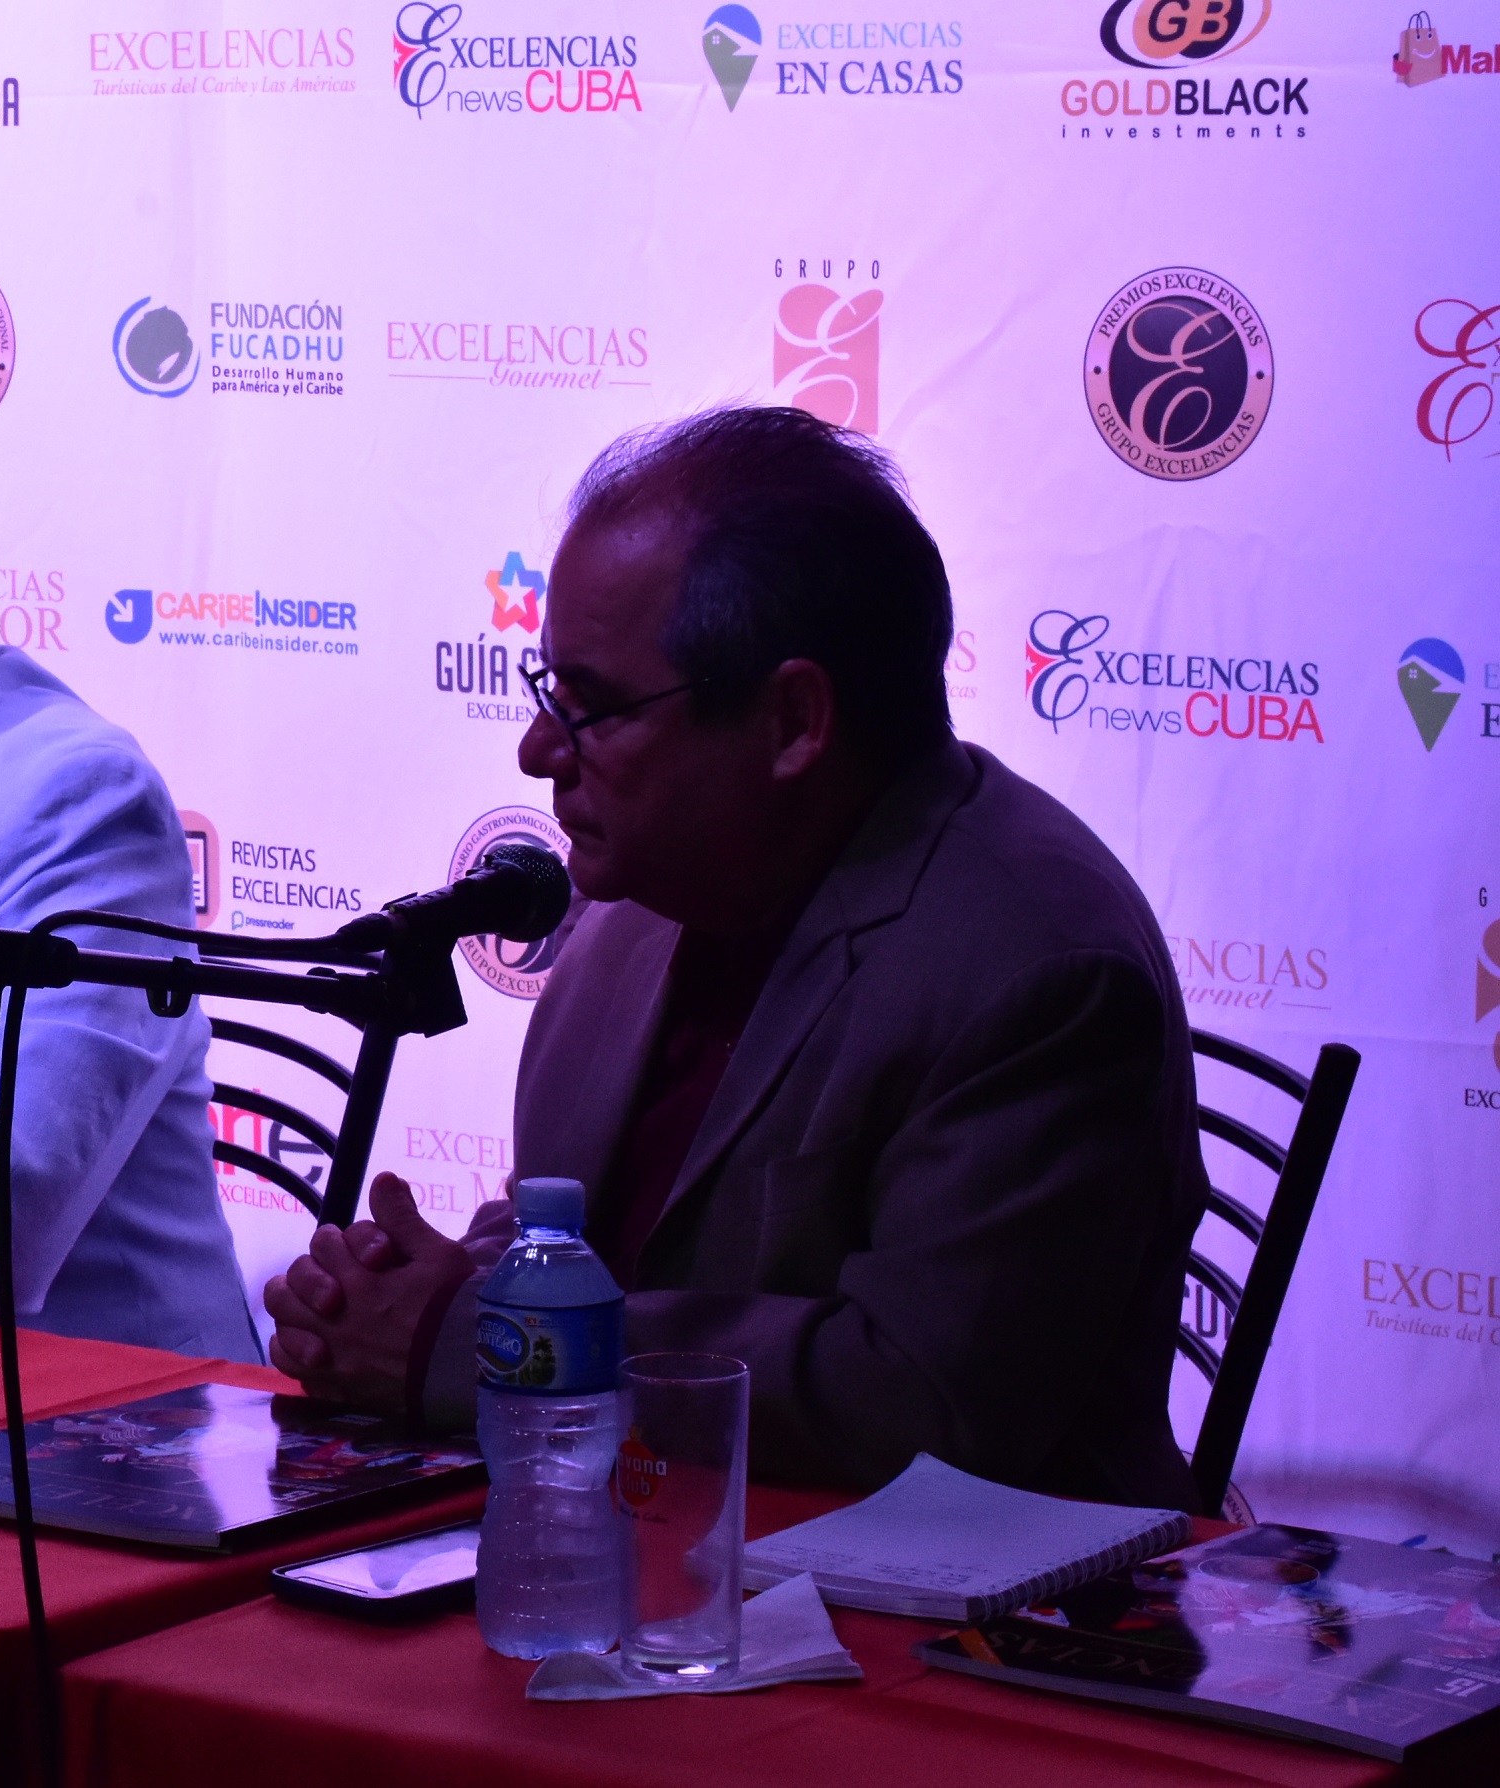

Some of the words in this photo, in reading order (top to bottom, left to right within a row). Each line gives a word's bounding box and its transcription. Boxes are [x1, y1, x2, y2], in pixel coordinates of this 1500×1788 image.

[89, 28, 355, 72] EXCELENCIAS
[778, 21, 963, 51] EXCELENCIAS
[91, 78, 167, 96] Turísticas
[172, 77, 198, 94] del
[202, 76, 248, 94] Caribe
[262, 76, 286, 93] Las
[290, 75, 357, 93] Américas
[776, 62, 829, 95] EN
[839, 60, 963, 95] CASAS
[1061, 77, 1309, 117] GOLDBLACK
[1061, 123, 1307, 139] investments
[774, 258, 881, 281] GRUPO
[211, 299, 342, 331] FUNDACIÓN
[1098, 276, 1162, 339] PREMIOS
[1164, 273, 1263, 347] EXCELENCIAS
[211, 333, 344, 362] FUCADHU
[386, 321, 650, 368] EXCELENCIAS
[212, 365, 279, 379] Desarrollo
[286, 368, 344, 382] Humano
[212, 381, 238, 394] para
[240, 380, 280, 394] América
[283, 384, 290, 397] y
[292, 381, 304, 394] el
[306, 381, 344, 396] Caribe
[1097, 402, 1142, 461] GRUPO
[1144, 411, 1255, 475] EXCELENCIAS
[159, 631, 359, 655] www.caribeinsider.com
[436, 633, 508, 696] GUÍA
[471, 813, 548, 844] GASTRONÓMICO
[231, 840, 316, 872] REVISTAS
[232, 876, 361, 912] EXCELENCIAS
[245, 916, 295, 930] pressreader
[1365, 1309, 1450, 1339] Turísticas
[1456, 1322, 1484, 1344] del
